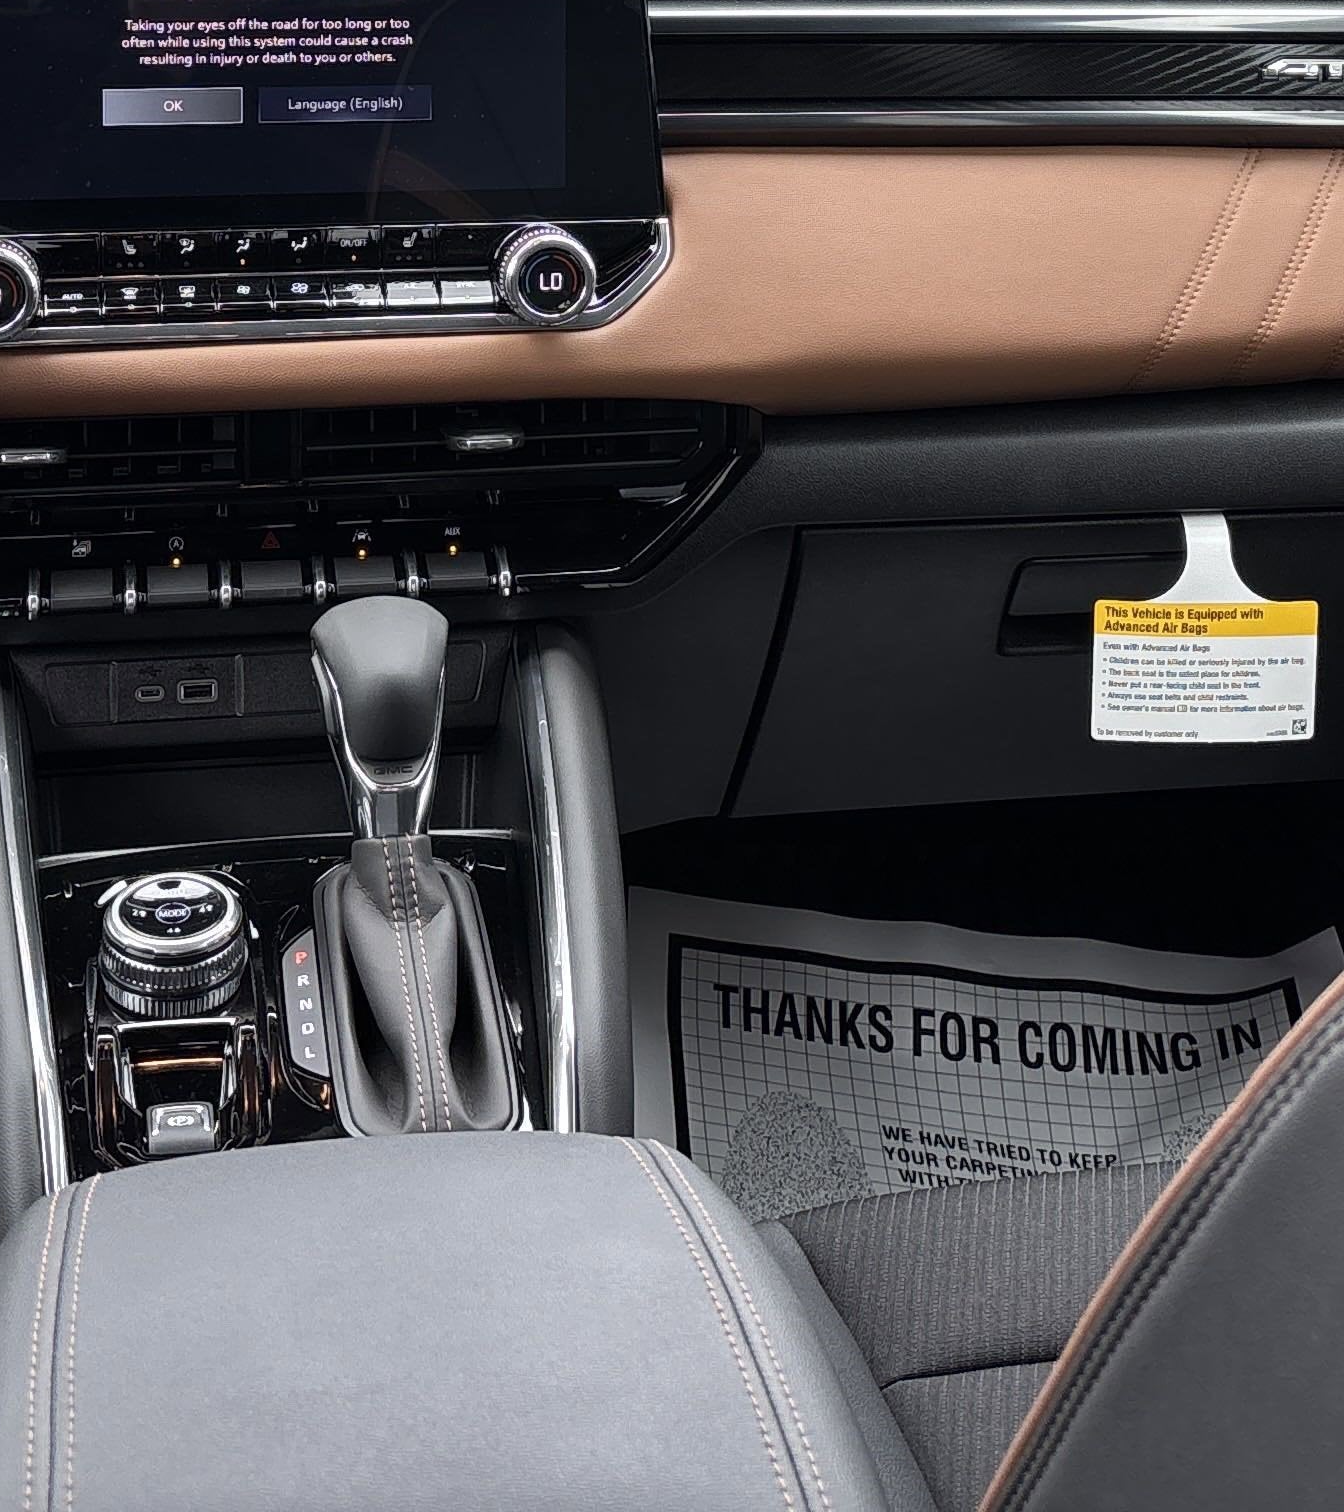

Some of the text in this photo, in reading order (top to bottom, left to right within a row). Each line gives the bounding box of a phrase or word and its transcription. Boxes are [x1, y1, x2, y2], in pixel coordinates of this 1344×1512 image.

[124, 17, 410, 33] Taking your eyes off the road for too long or too
[121, 34, 413, 50] often while using this system could cause a crash
[139, 50, 396, 68] resulting in injury or death to you or others.
[163, 96, 404, 112] OK Language (English)
[340, 238, 368, 248] ON/OFF
[538, 272, 563, 291] LO
[62, 292, 84, 300] AUTO
[444, 527, 461, 537] AUX
[1104, 605, 1264, 623] This Vehicle is Equipped with
[1103, 620, 1209, 635] Advanced Air Bags
[1103, 641, 1211, 654] Even with Advanced Air Bags
[1109, 656, 1140, 665] Children
[1156, 658, 1166, 666] be
[1167, 658, 1187, 666] killed
[1198, 658, 1229, 667] seriously
[1231, 658, 1256, 667] injured
[1257, 657, 1266, 667] by
[1267, 657, 1279, 665] the
[1280, 657, 1290, 665] air
[1096, 728, 1199, 739] To be removed by customer only
[294, 950, 309, 965] P
[296, 974, 310, 987] R
[299, 998, 314, 1010] N
[301, 1022, 316, 1035] D
[711, 981, 1263, 1077] THANKS FOR COMING IN
[304, 1046, 316, 1059] L
[881, 1123, 1118, 1170] WE HAVE TRIED TO KEEP
[882, 1145, 940, 1168] YOUR
[897, 1167, 950, 1189] WITH
